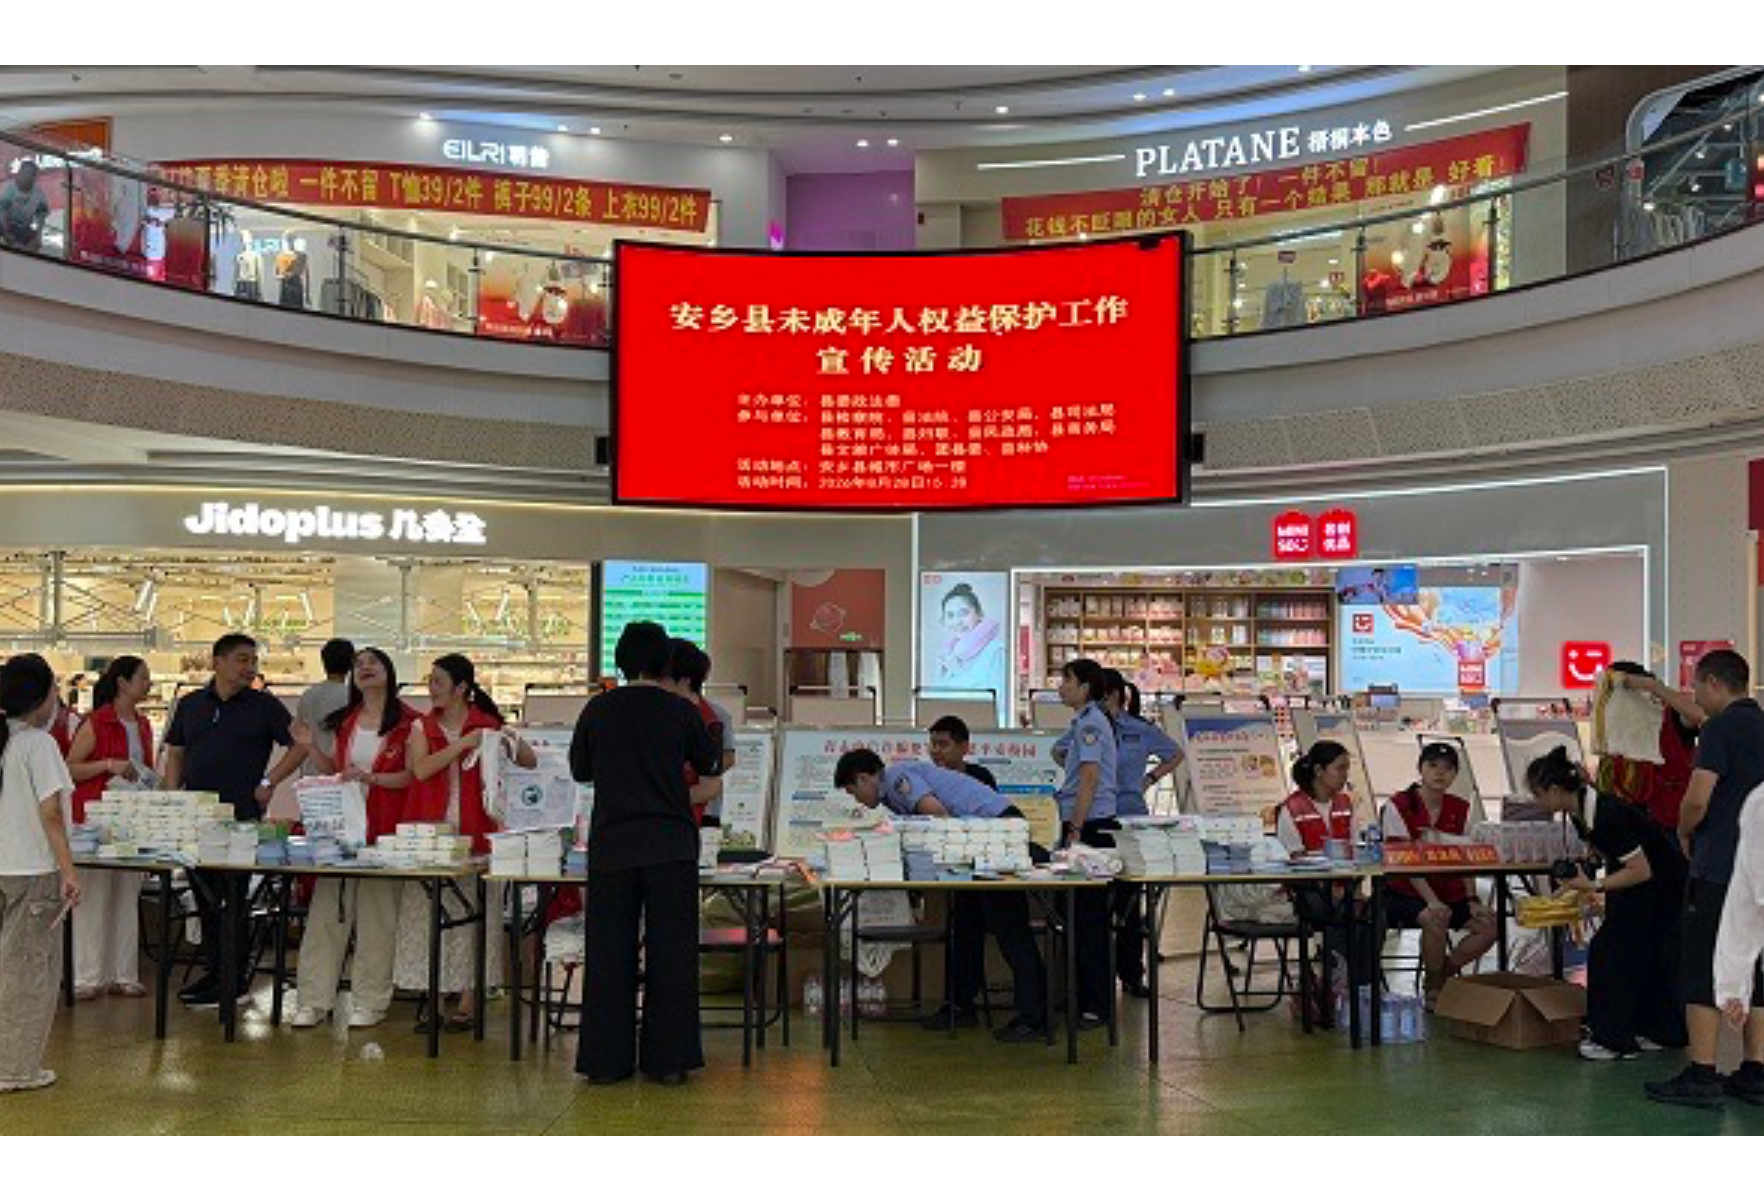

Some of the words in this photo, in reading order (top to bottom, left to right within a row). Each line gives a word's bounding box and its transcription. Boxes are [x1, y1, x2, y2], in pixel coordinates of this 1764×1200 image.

[1136, 127, 1300, 177] PLATANE
[300, 167, 379, 201] 一件不留
[669, 294, 1130, 336] 安乡县未成年人权益保护工作
[816, 345, 985, 375] 宣传活动
[183, 501, 385, 543] Jidoplus
